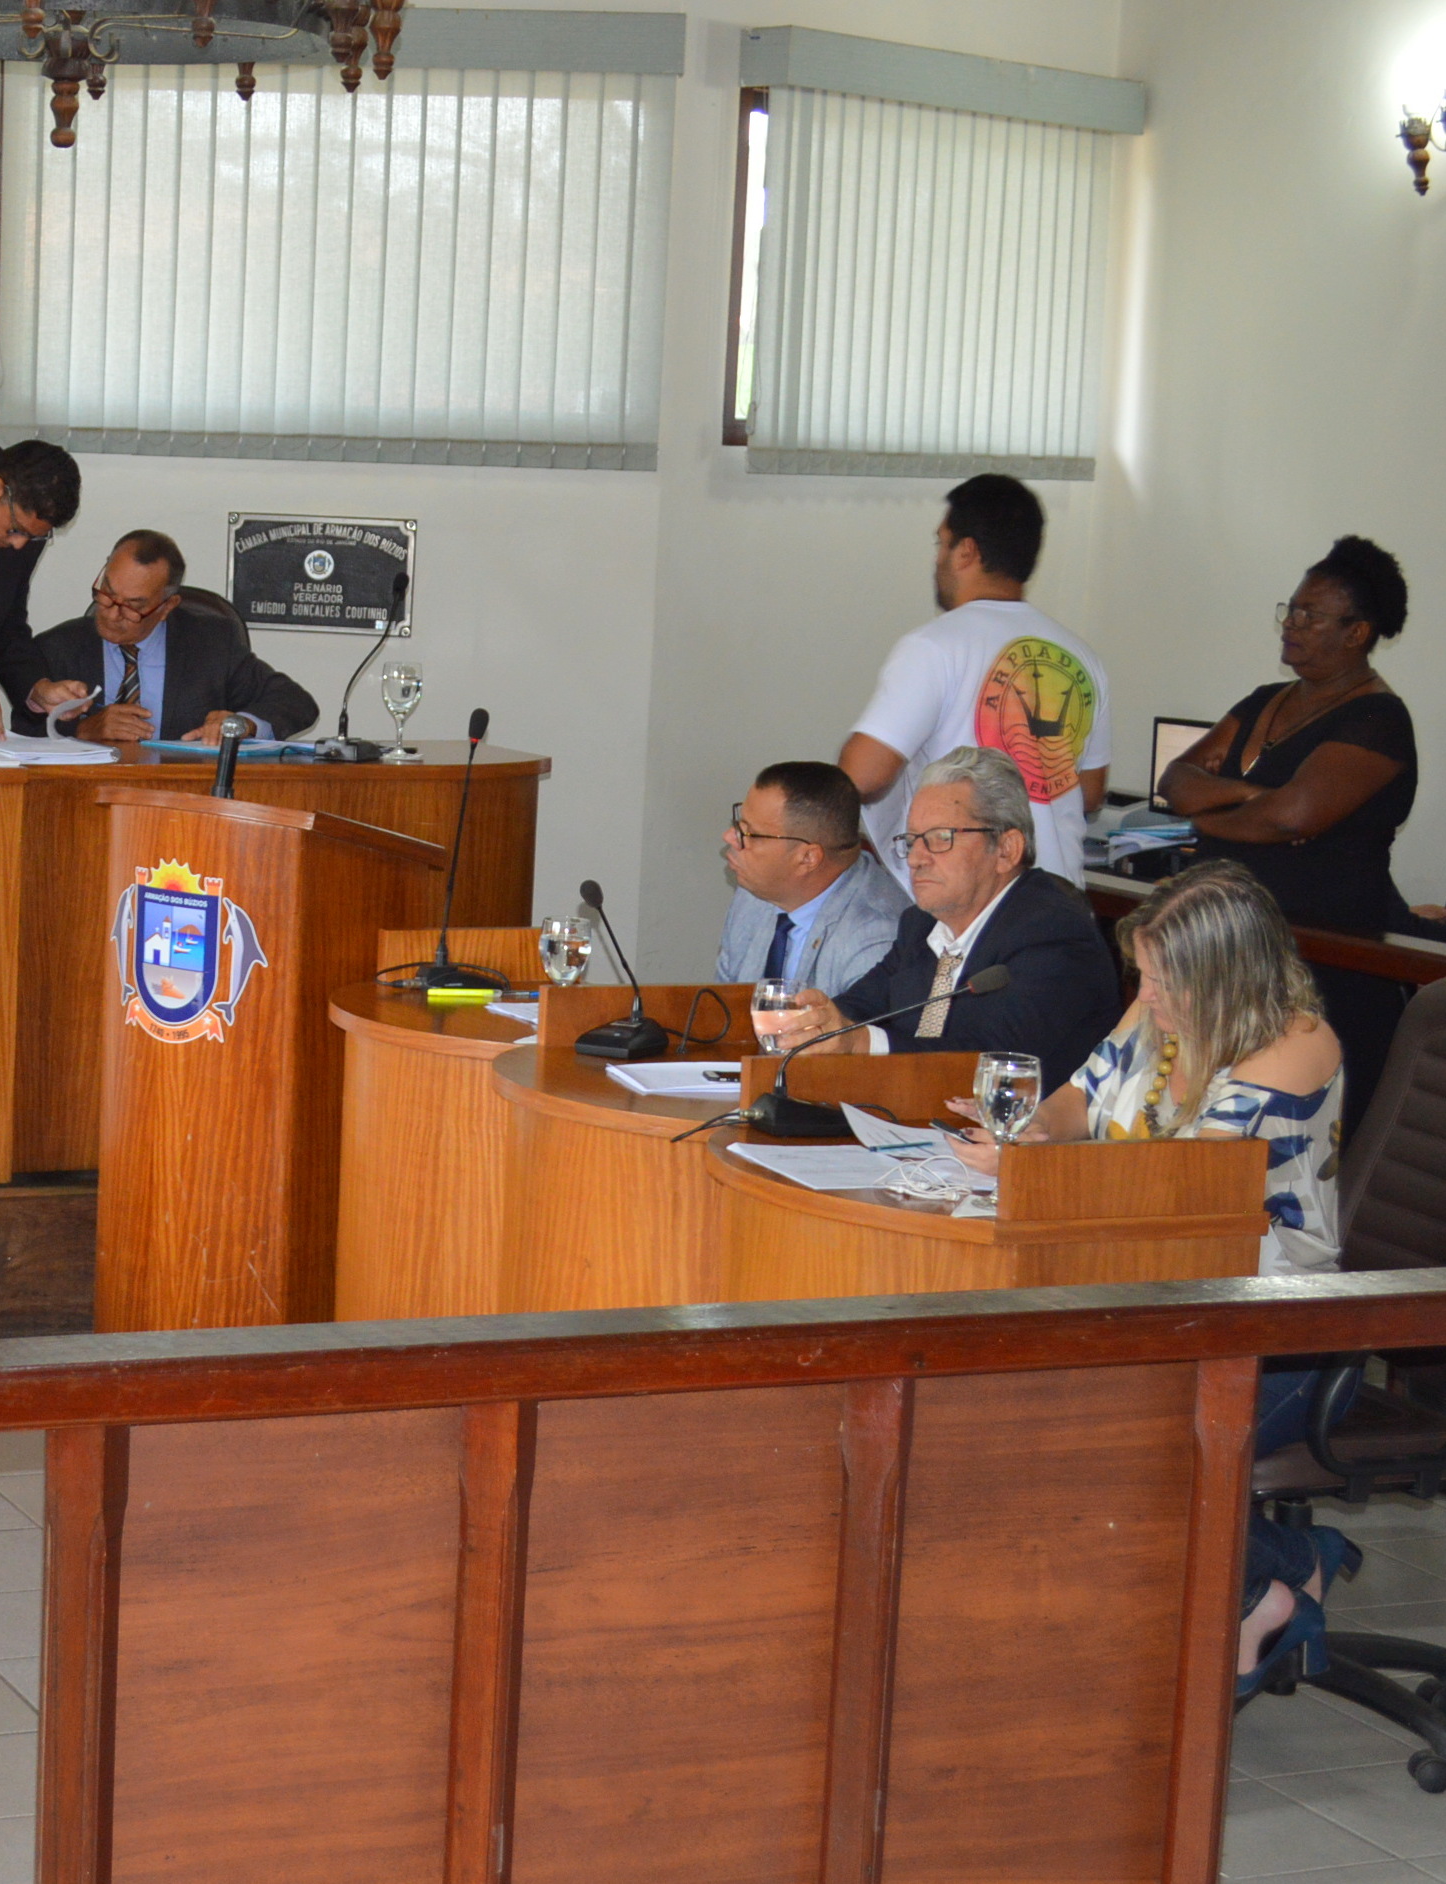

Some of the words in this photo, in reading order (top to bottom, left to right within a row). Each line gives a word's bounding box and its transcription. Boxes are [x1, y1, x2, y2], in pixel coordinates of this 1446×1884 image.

[268, 522, 311, 541] MUNICIPAL
[312, 522, 324, 535] DE
[363, 531, 381, 547] DOS
[293, 582, 342, 593] PLENÁRIO
[293, 593, 343, 604] VEREADOR
[345, 605, 387, 620] COUTINHO
